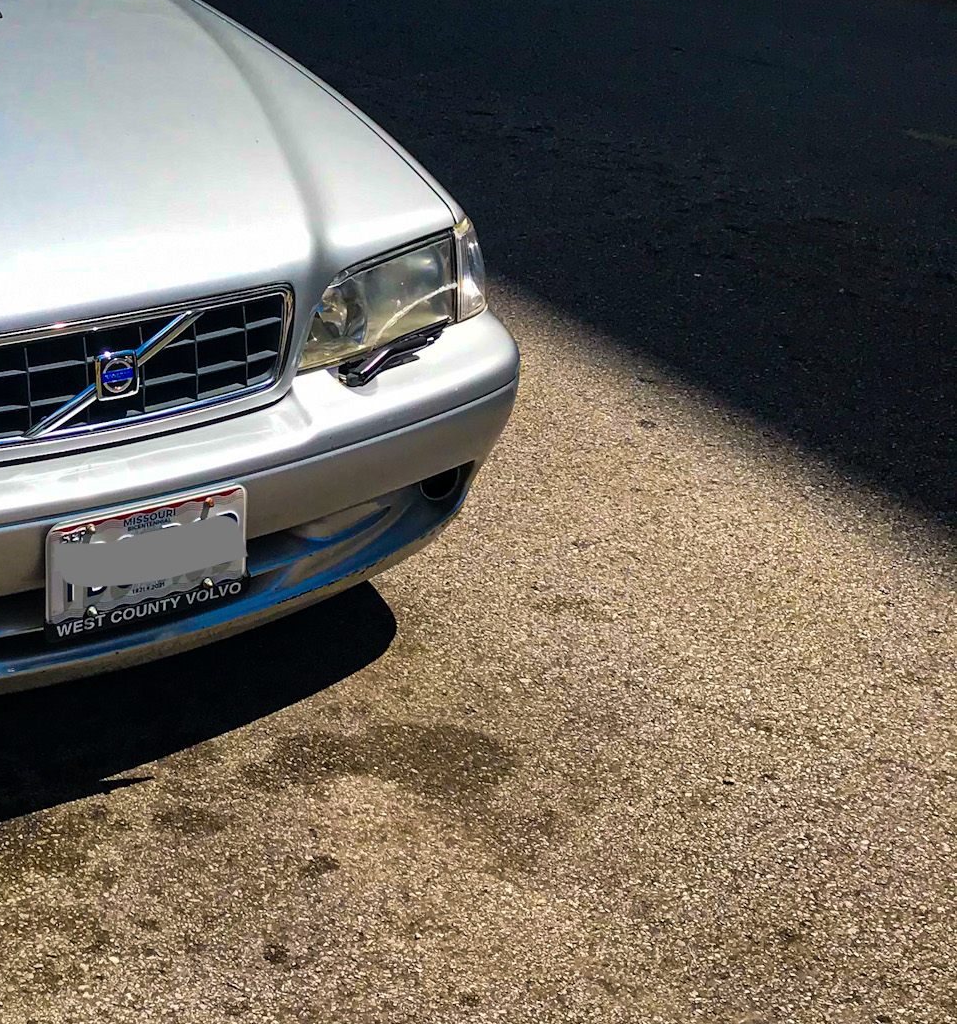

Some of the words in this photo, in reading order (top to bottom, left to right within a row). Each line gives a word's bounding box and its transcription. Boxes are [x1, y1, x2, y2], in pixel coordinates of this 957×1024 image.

[123, 509, 176, 528] MISSOURI
[127, 517, 171, 532] BICENTENNIAL
[61, 530, 86, 544] SEP
[56, 613, 106, 637] WEST
[110, 596, 181, 623] COUNTY
[185, 582, 242, 605] VOLVO
